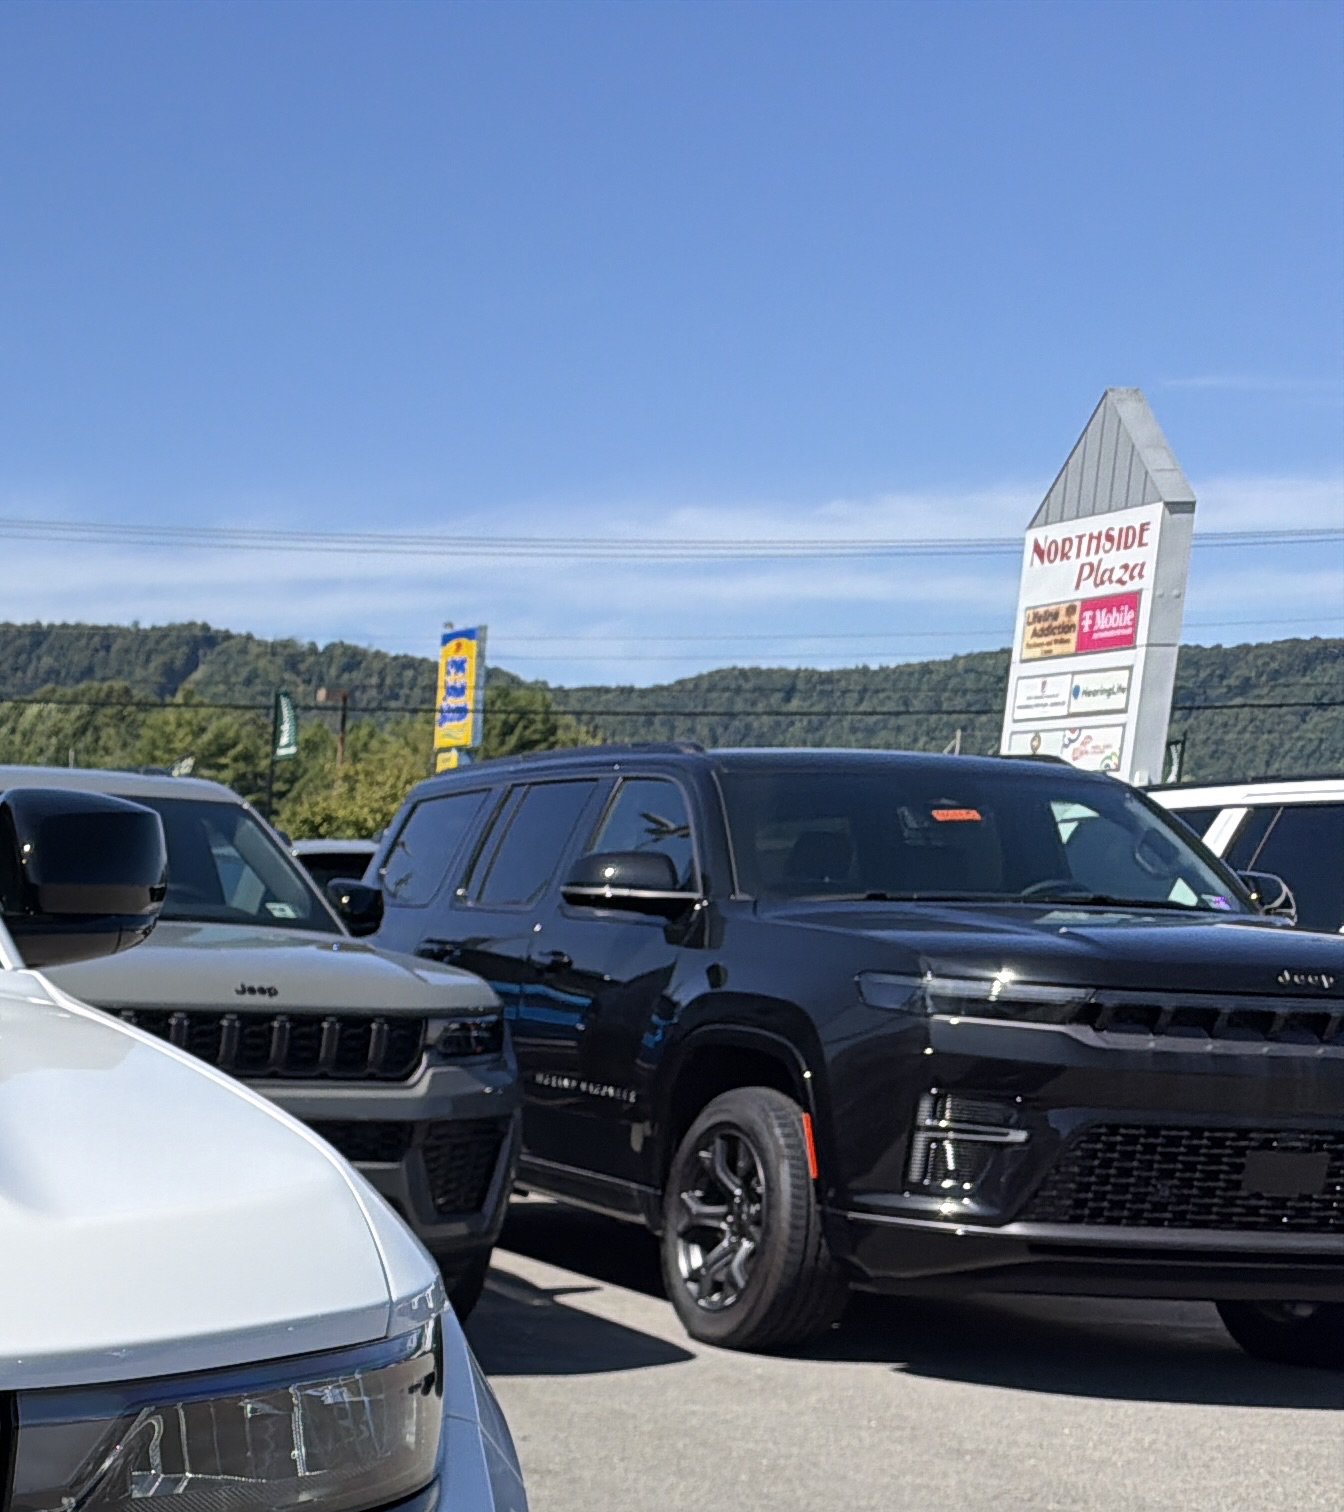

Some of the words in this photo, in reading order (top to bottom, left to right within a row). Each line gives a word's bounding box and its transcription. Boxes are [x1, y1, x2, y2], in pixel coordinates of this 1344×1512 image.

[1030, 521, 1151, 567] NORTHSIDE
[1074, 557, 1146, 590] Plaza
[235, 981, 279, 998] Jeep
